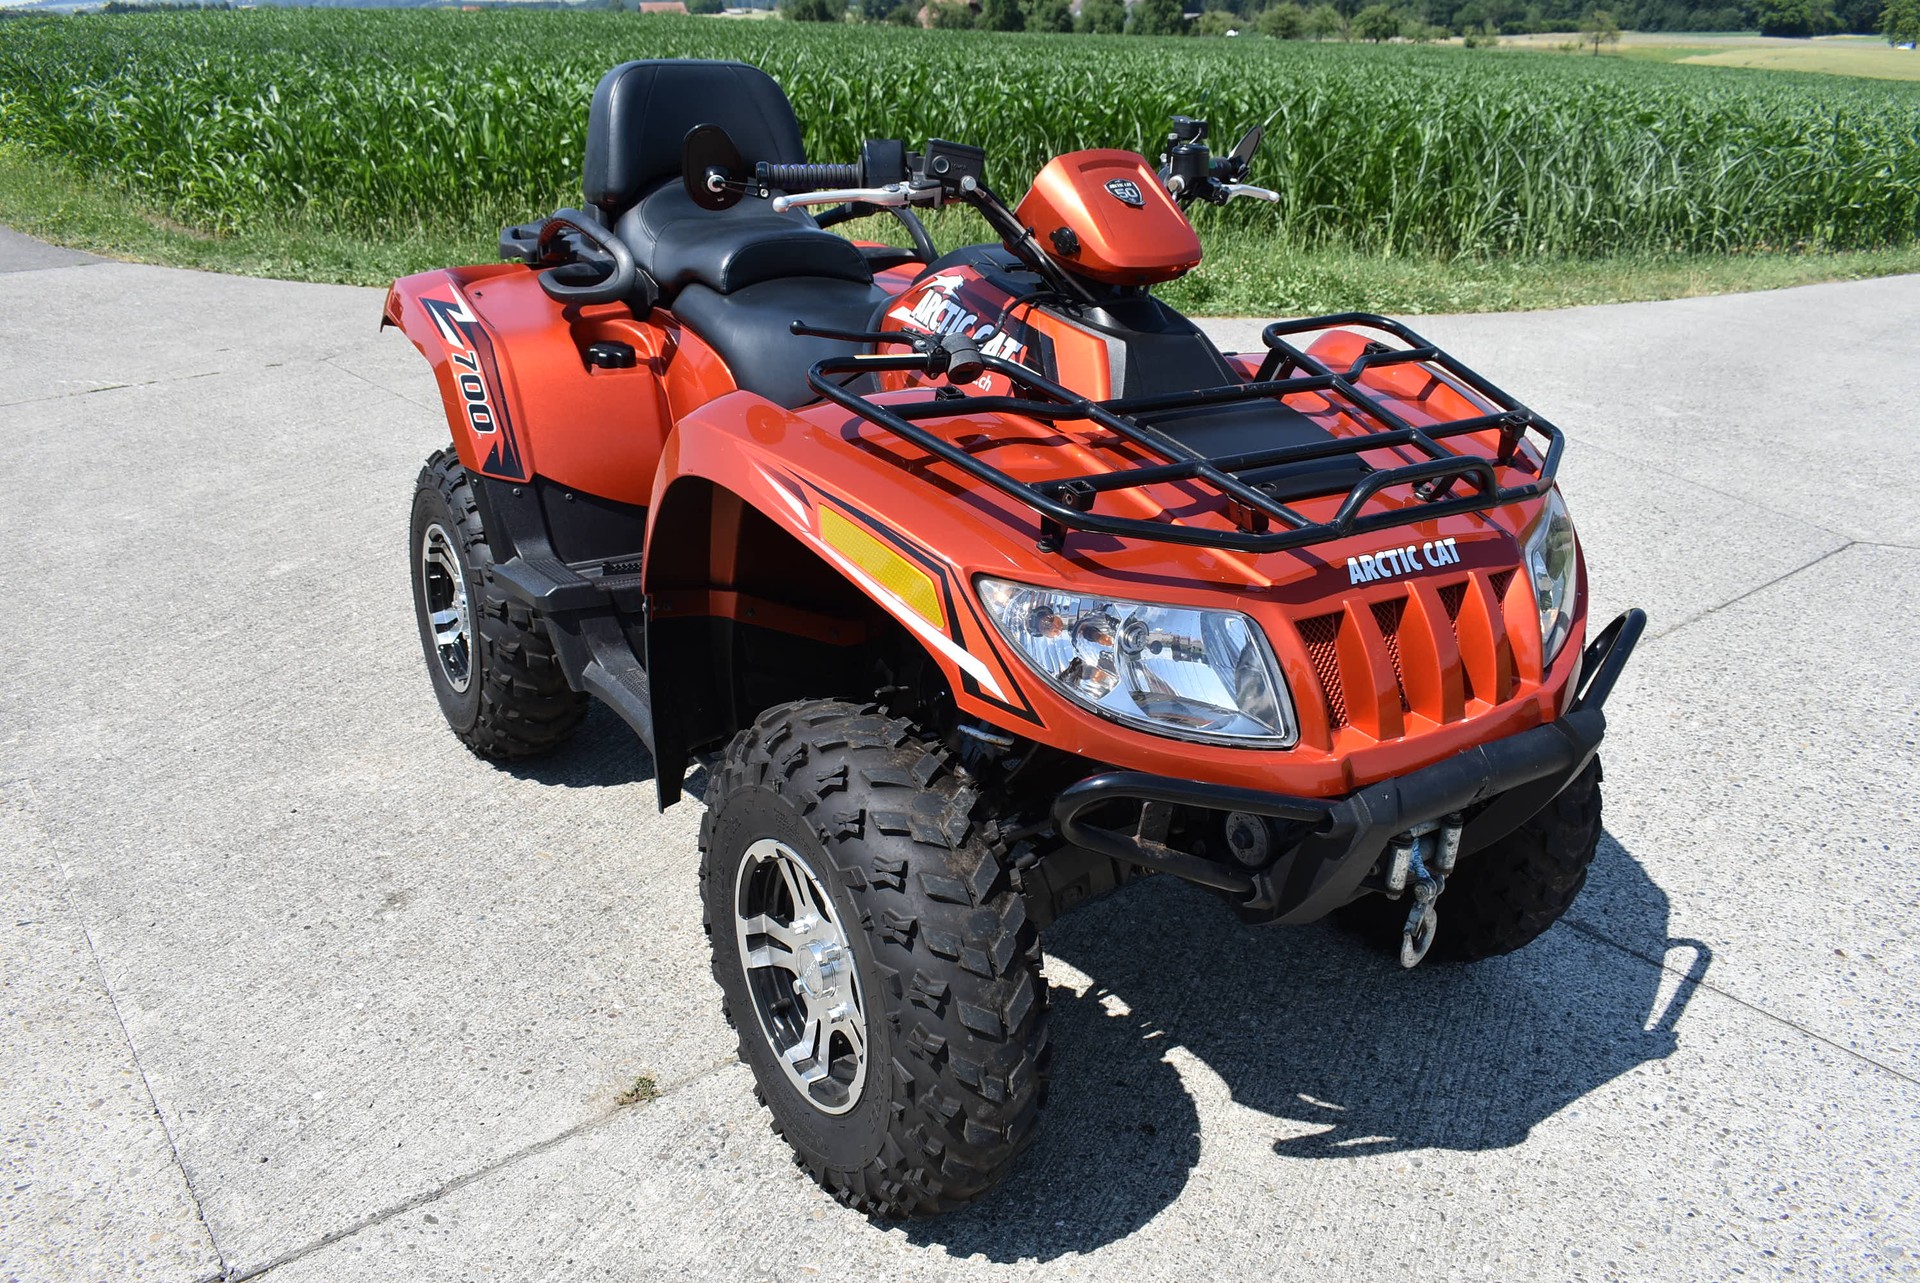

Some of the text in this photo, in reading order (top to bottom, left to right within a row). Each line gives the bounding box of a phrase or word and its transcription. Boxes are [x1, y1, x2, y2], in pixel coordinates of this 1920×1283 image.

[1114, 187, 1138, 198] 50
[911, 288, 978, 339] ARCTIC
[452, 350, 497, 434] 700
[1346, 537, 1461, 585] ARCTIC CAT
